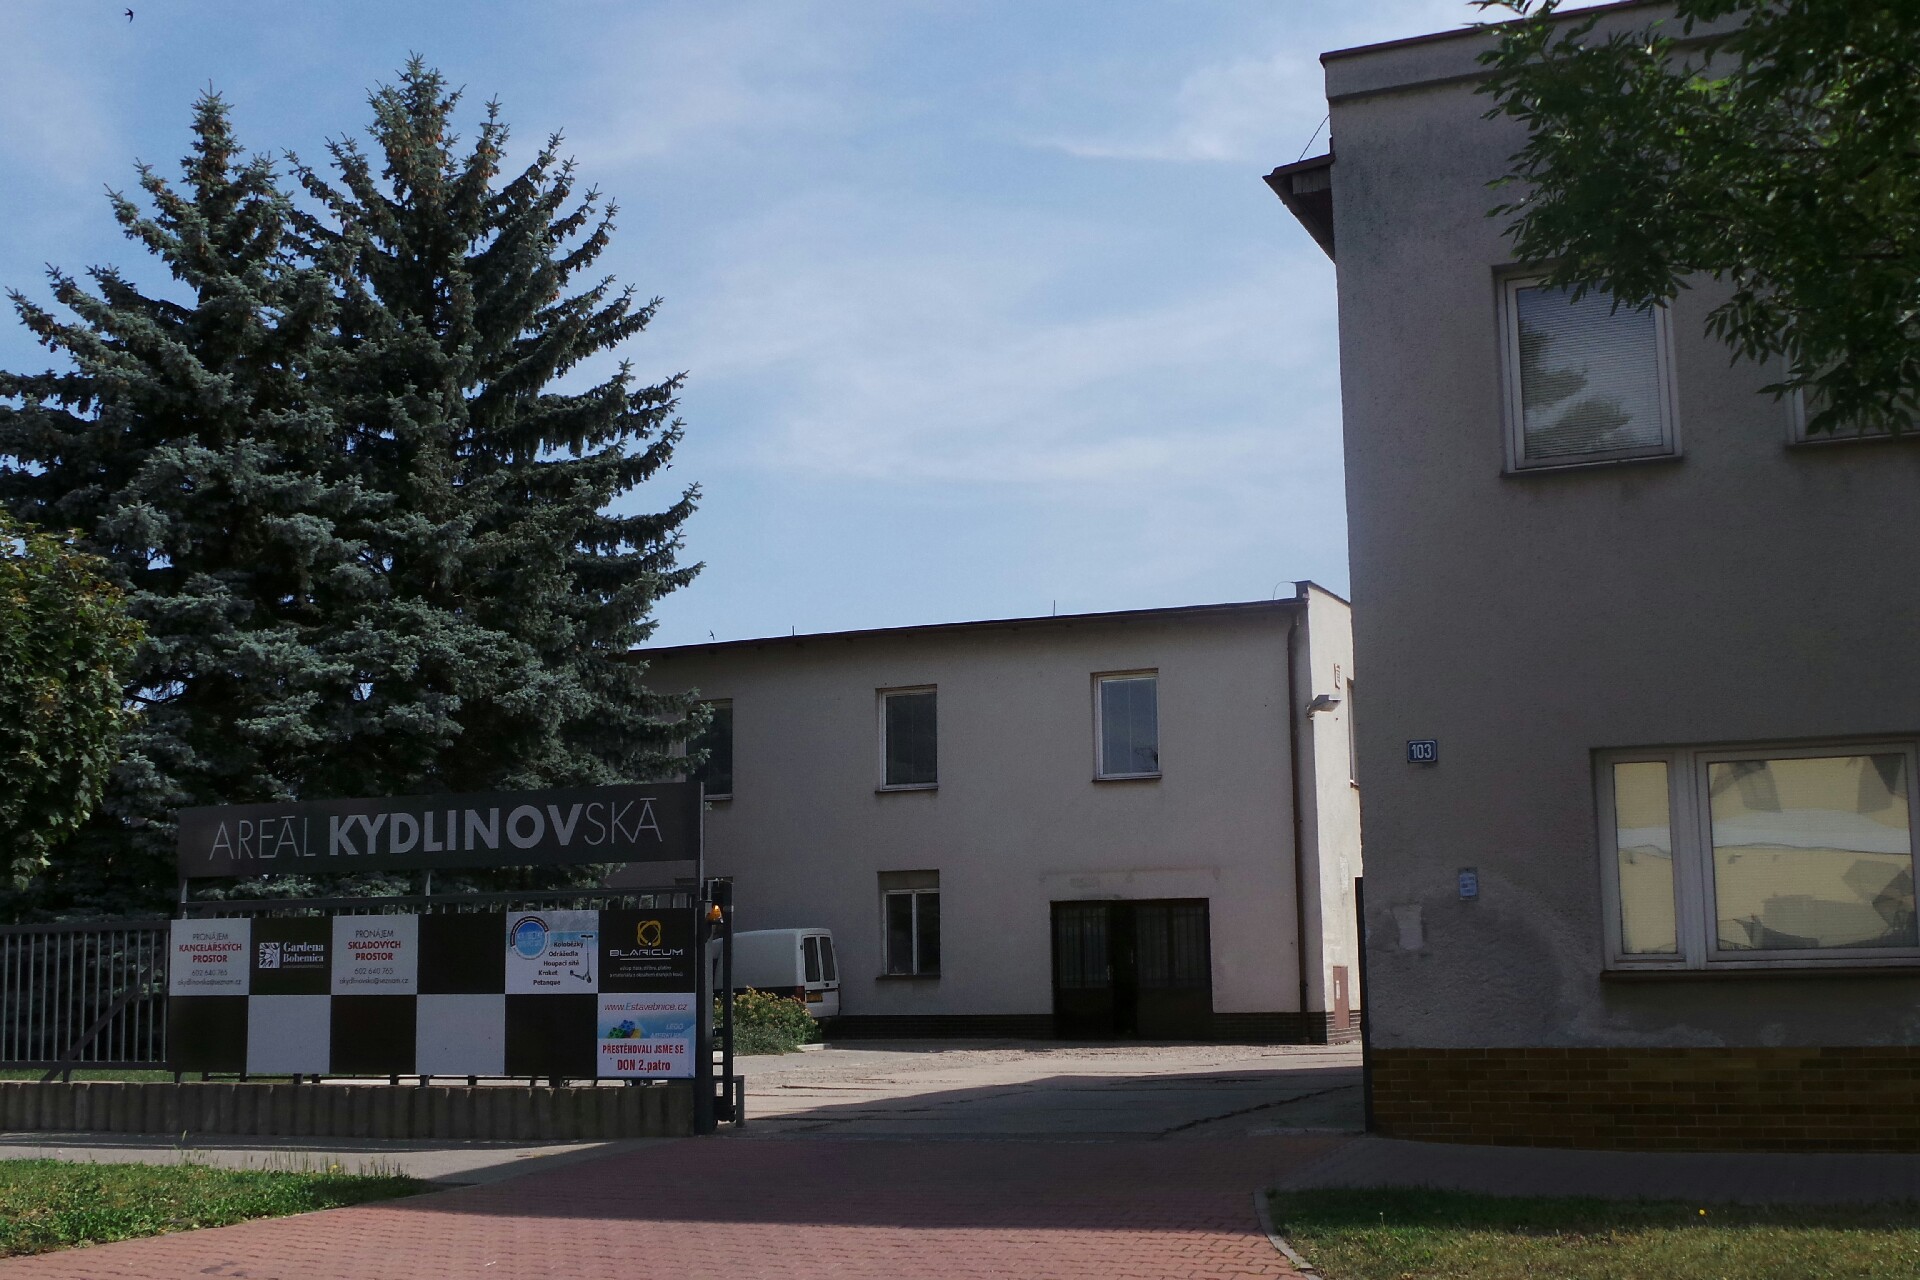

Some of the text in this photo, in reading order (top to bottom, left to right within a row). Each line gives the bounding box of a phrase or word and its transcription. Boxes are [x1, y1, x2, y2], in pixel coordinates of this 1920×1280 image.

[1411, 744, 1432, 759] 103
[192, 932, 229, 941] PRONÁJEM
[355, 928, 394, 938] PRONÁJEM
[179, 942, 242, 952] KANCELÁŘSKÝCH
[283, 941, 324, 952] Gardena
[347, 939, 401, 949] SKLADOVÝCH
[355, 952, 394, 961] PROSTOR
[609, 948, 684, 957] BLARICUM
[192, 955, 228, 963] PROSTOR
[283, 953, 324, 963] Bohemica
[382, 967, 394, 975] 765
[604, 1002, 688, 1011] www.Estavebnice.cz
[602, 1042, 684, 1054] PŘESTĚHOVALI JSME SE
[617, 1059, 671, 1073] DON 2.patro
